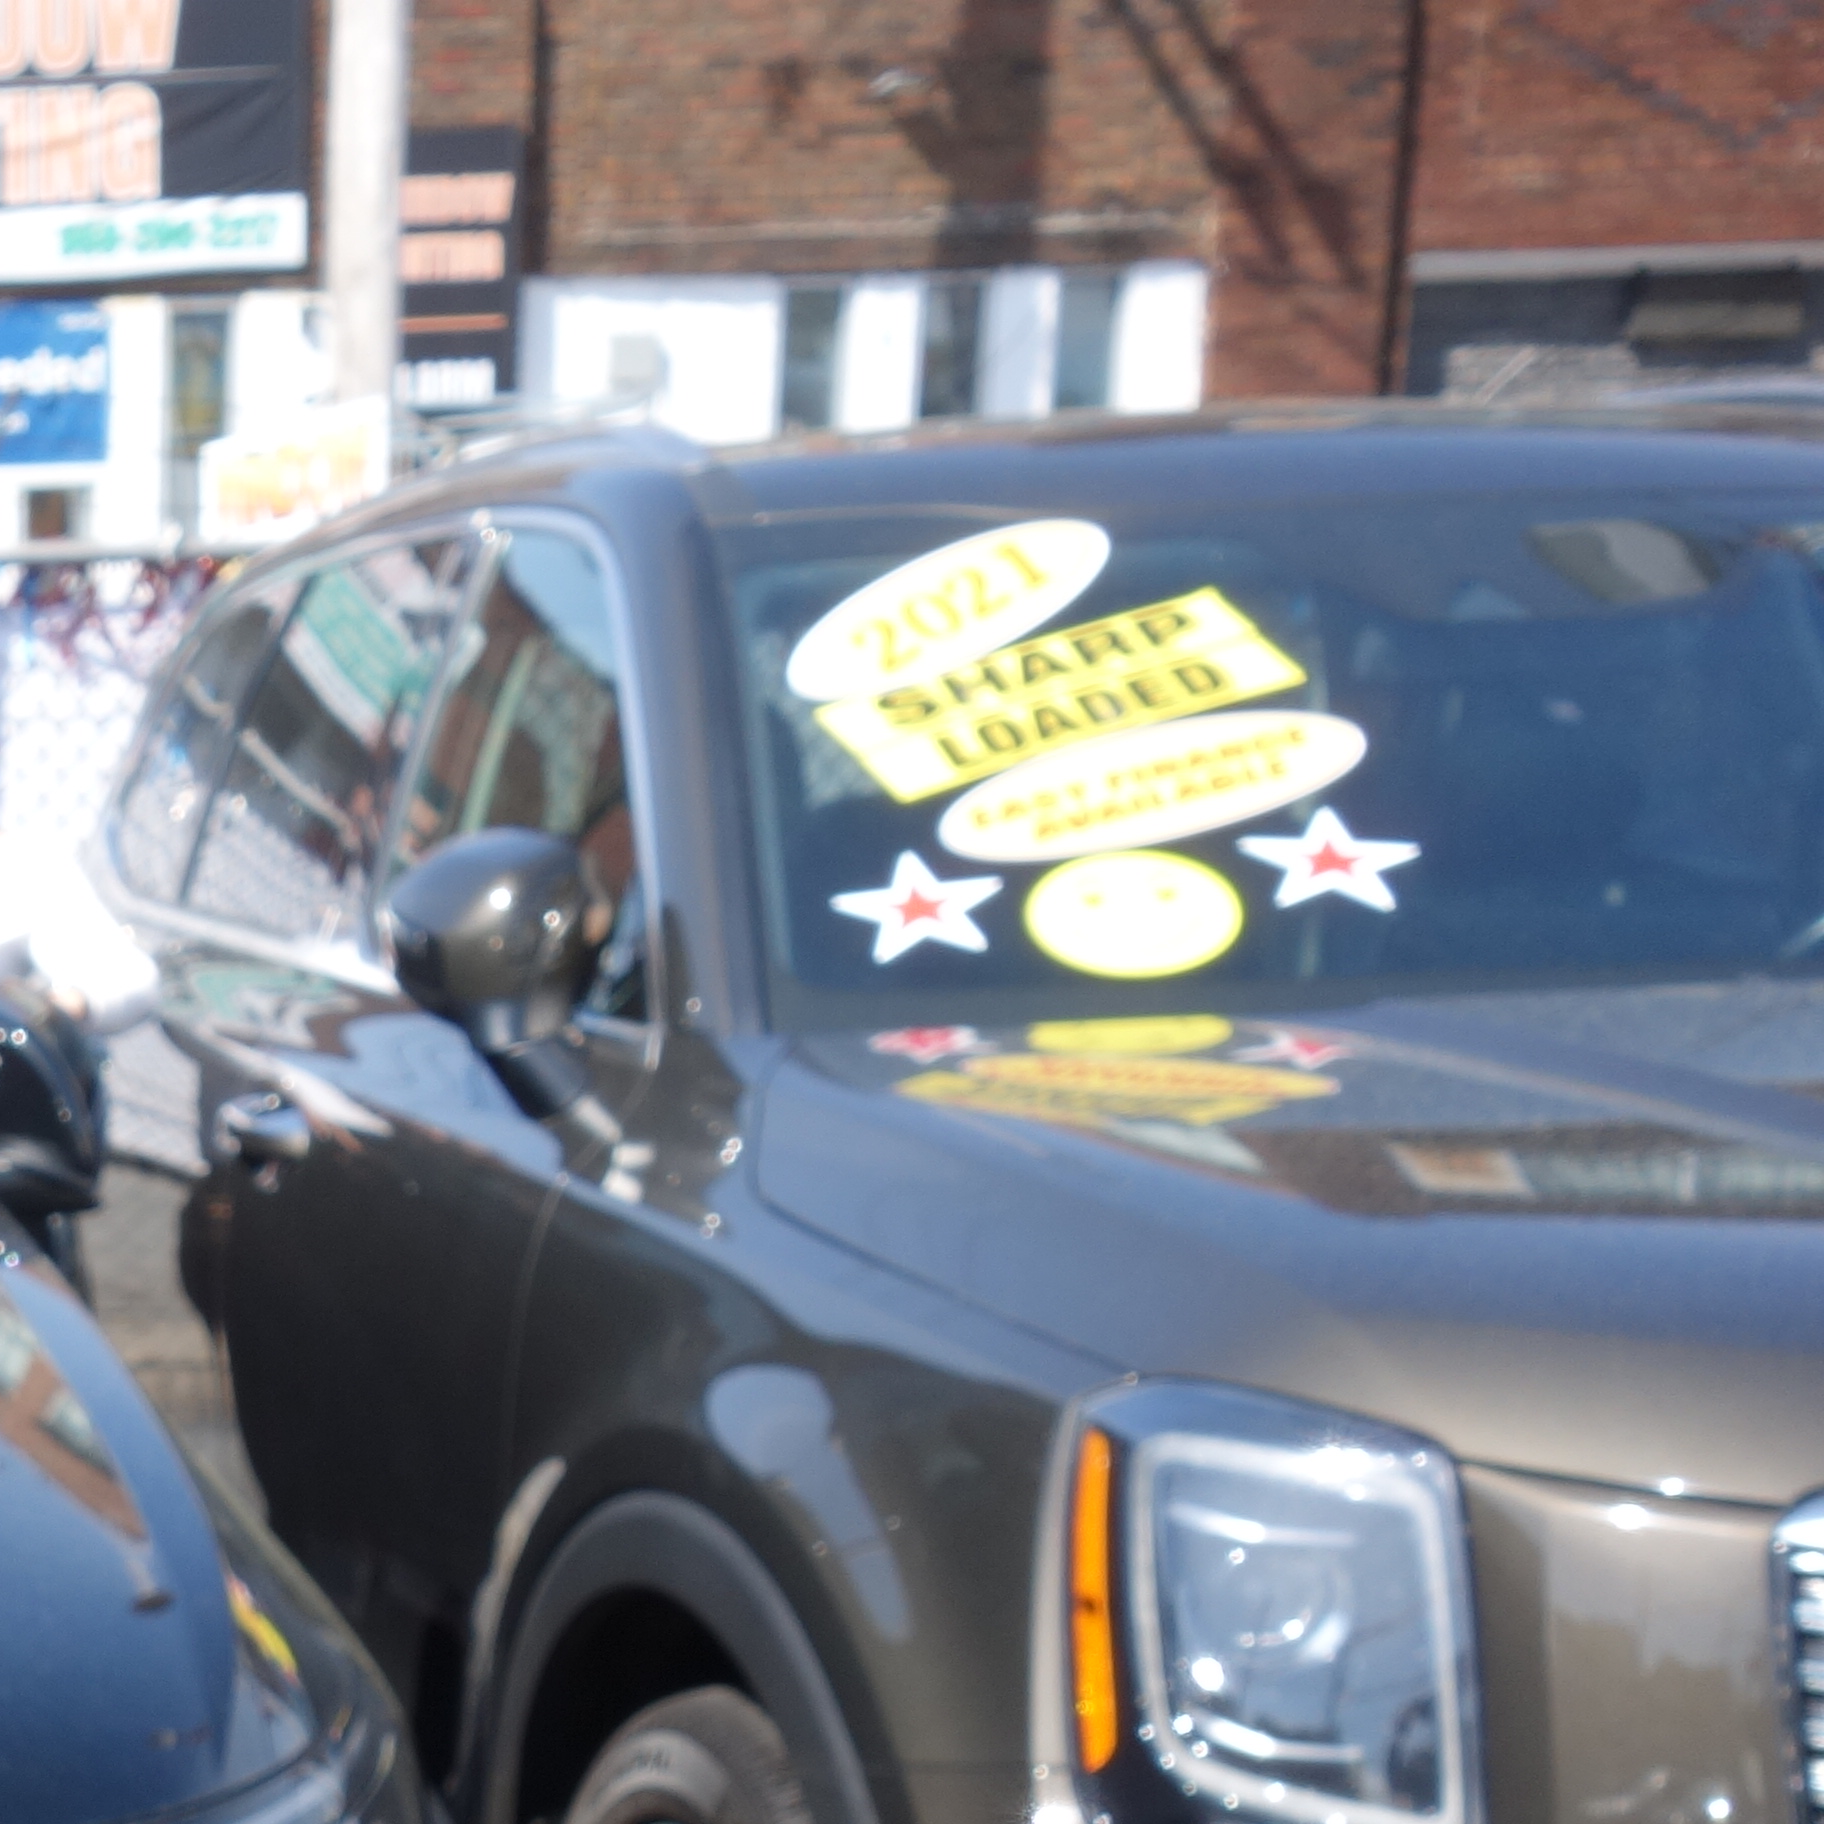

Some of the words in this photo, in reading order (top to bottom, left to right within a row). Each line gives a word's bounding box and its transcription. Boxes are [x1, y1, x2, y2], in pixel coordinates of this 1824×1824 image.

[851, 539, 1049, 673] 2021
[876, 606, 1195, 726] SHARP
[936, 660, 1229, 767] LOADED
[969, 779, 1088, 829] EASY
[1103, 725, 1310, 791] FINANCE
[1033, 755, 1290, 844] AVAILABLE
